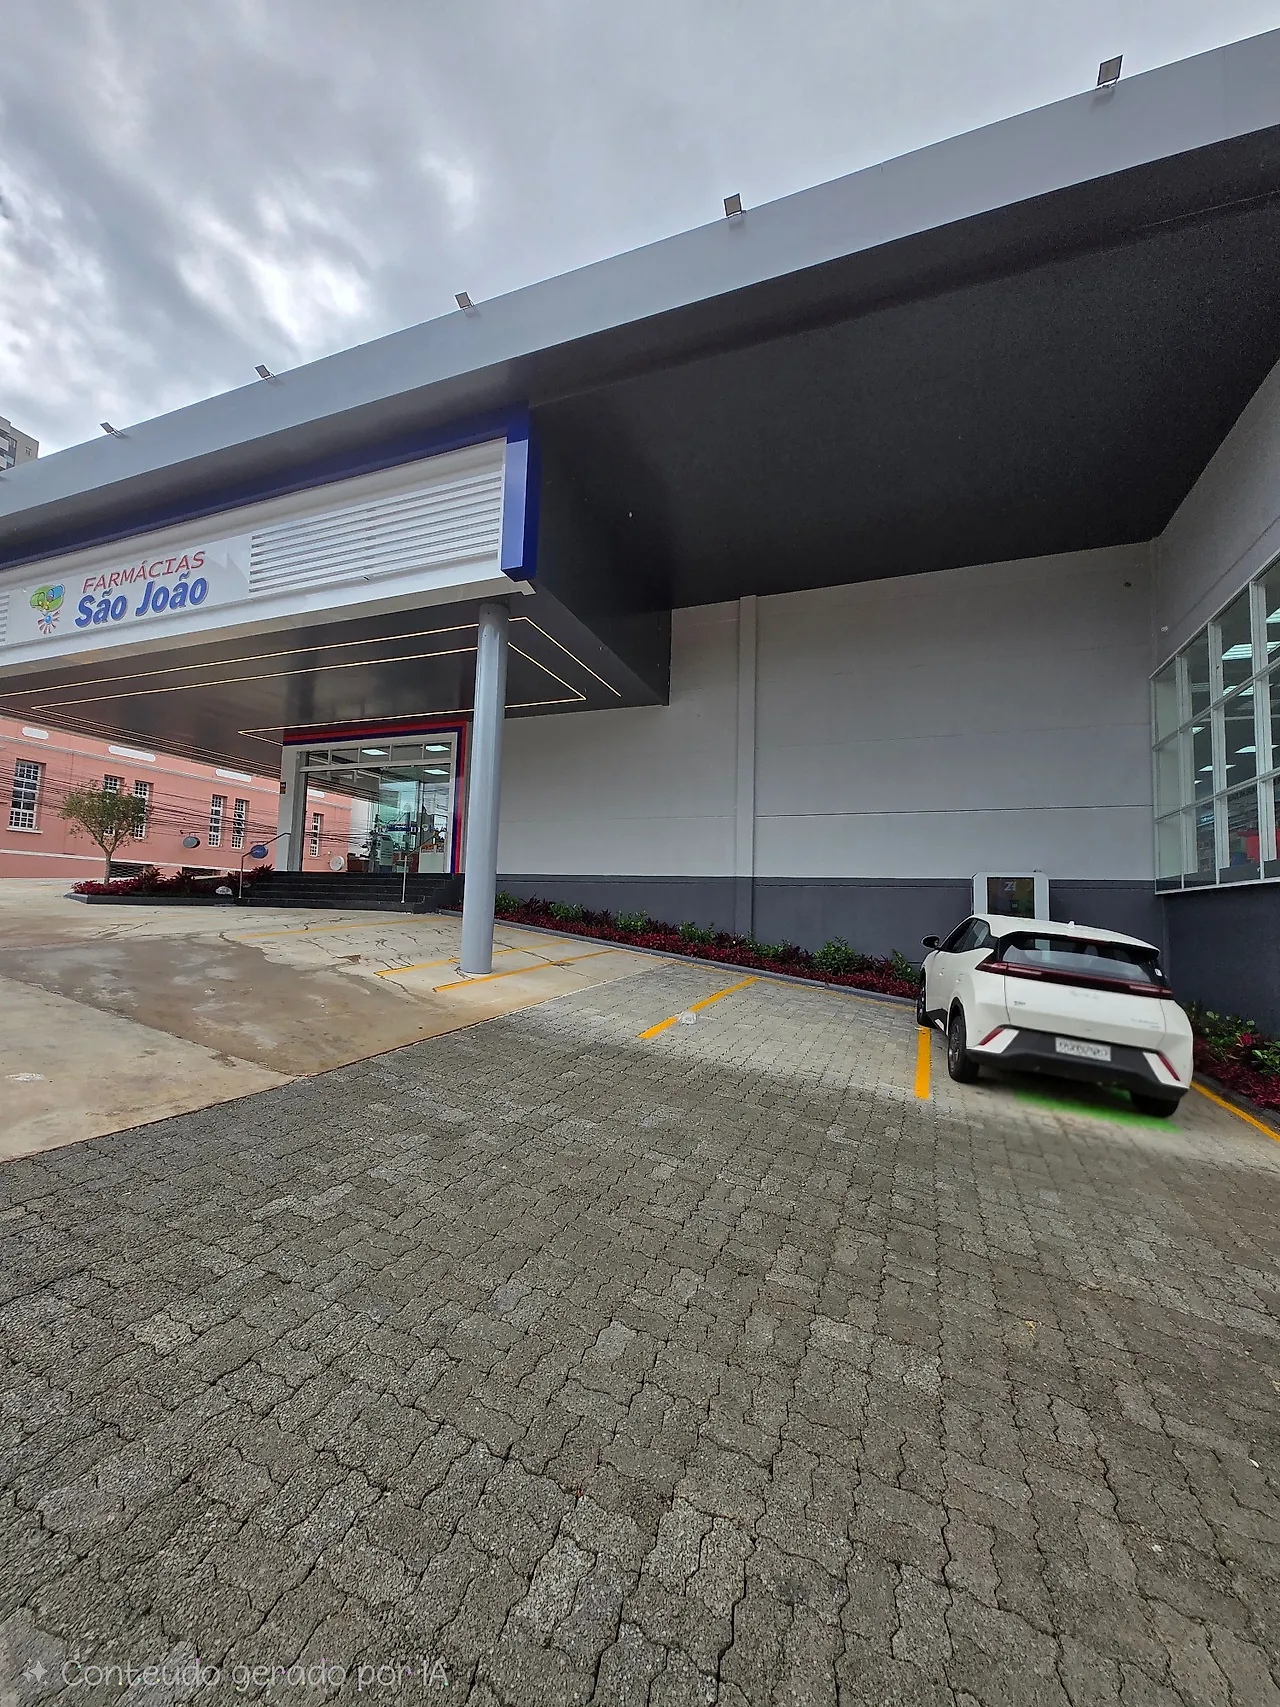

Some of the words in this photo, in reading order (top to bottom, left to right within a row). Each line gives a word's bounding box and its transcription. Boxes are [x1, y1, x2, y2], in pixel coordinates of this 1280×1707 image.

[82, 551, 206, 593] FARMÁCIAS
[74, 588, 128, 628] São
[135, 571, 209, 617] João
